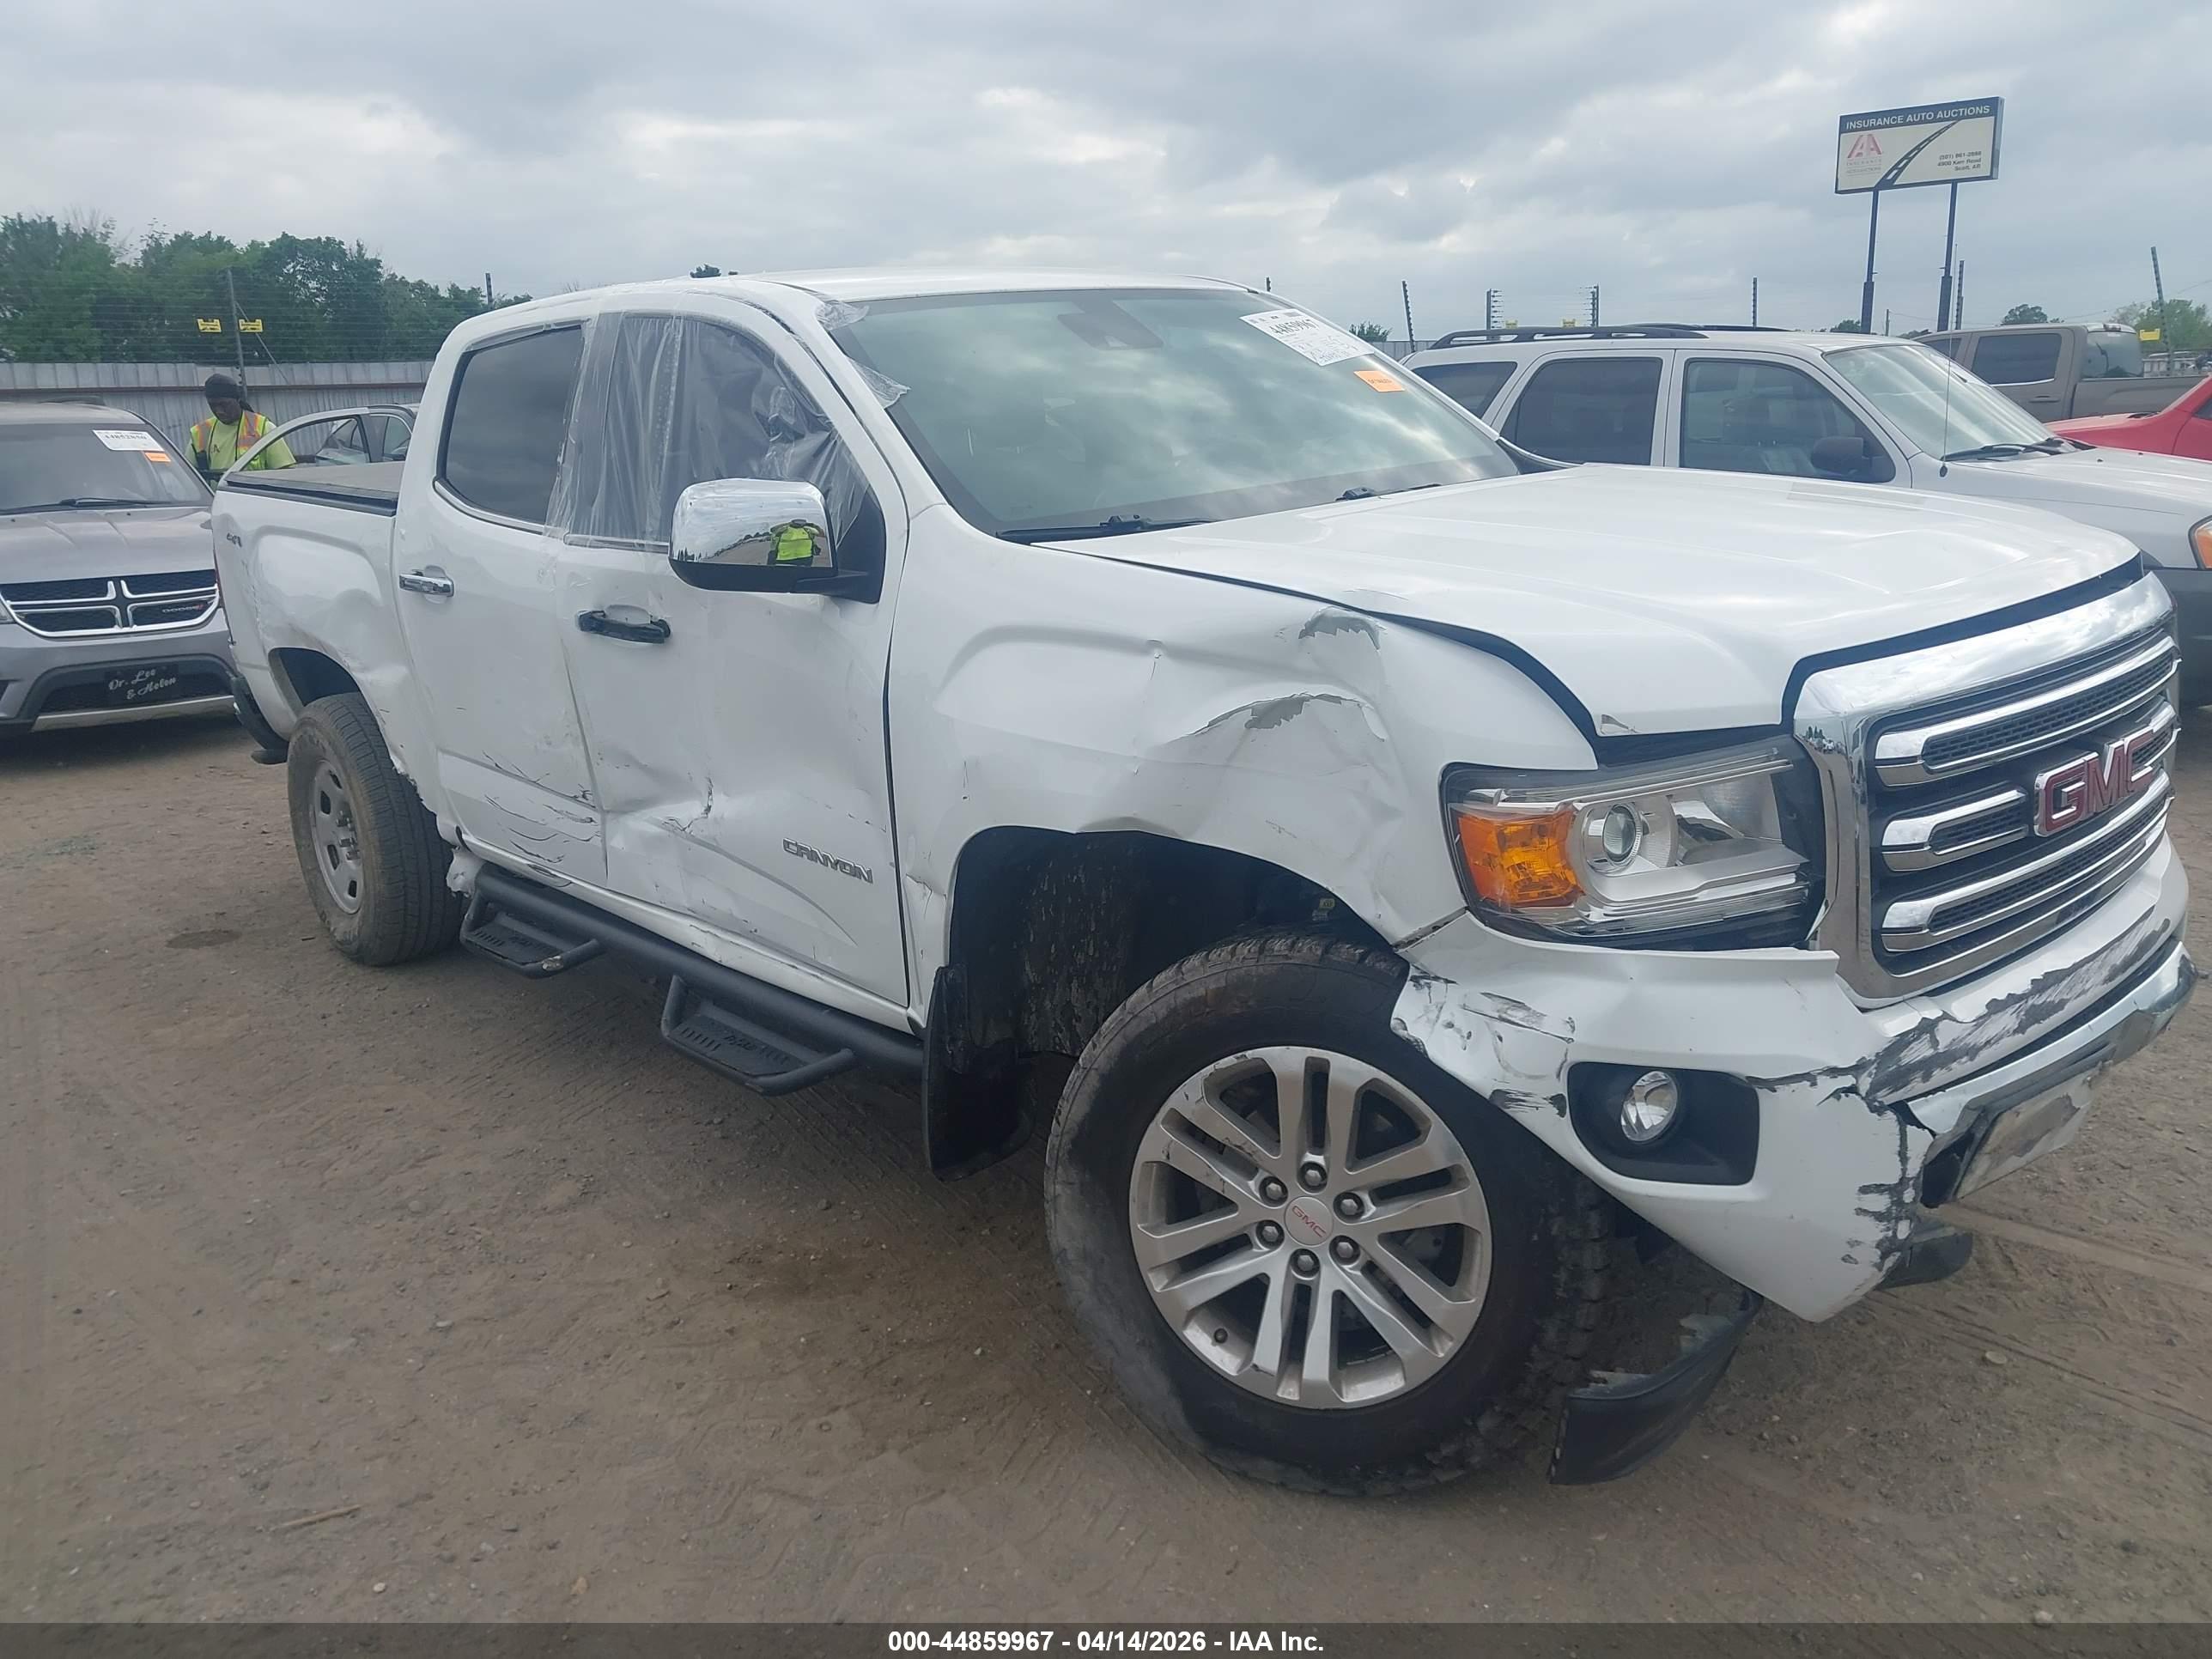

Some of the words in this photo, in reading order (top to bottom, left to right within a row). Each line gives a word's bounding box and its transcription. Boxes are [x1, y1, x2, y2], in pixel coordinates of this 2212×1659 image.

[1846, 115, 1904, 130] INSURANCE
[1906, 111, 1935, 122] AUTO
[1936, 105, 1990, 118] AUCTIONS
[2034, 726, 2154, 837] GMC
[782, 837, 874, 884] CANYON
[1291, 1205, 1327, 1238] GMC
